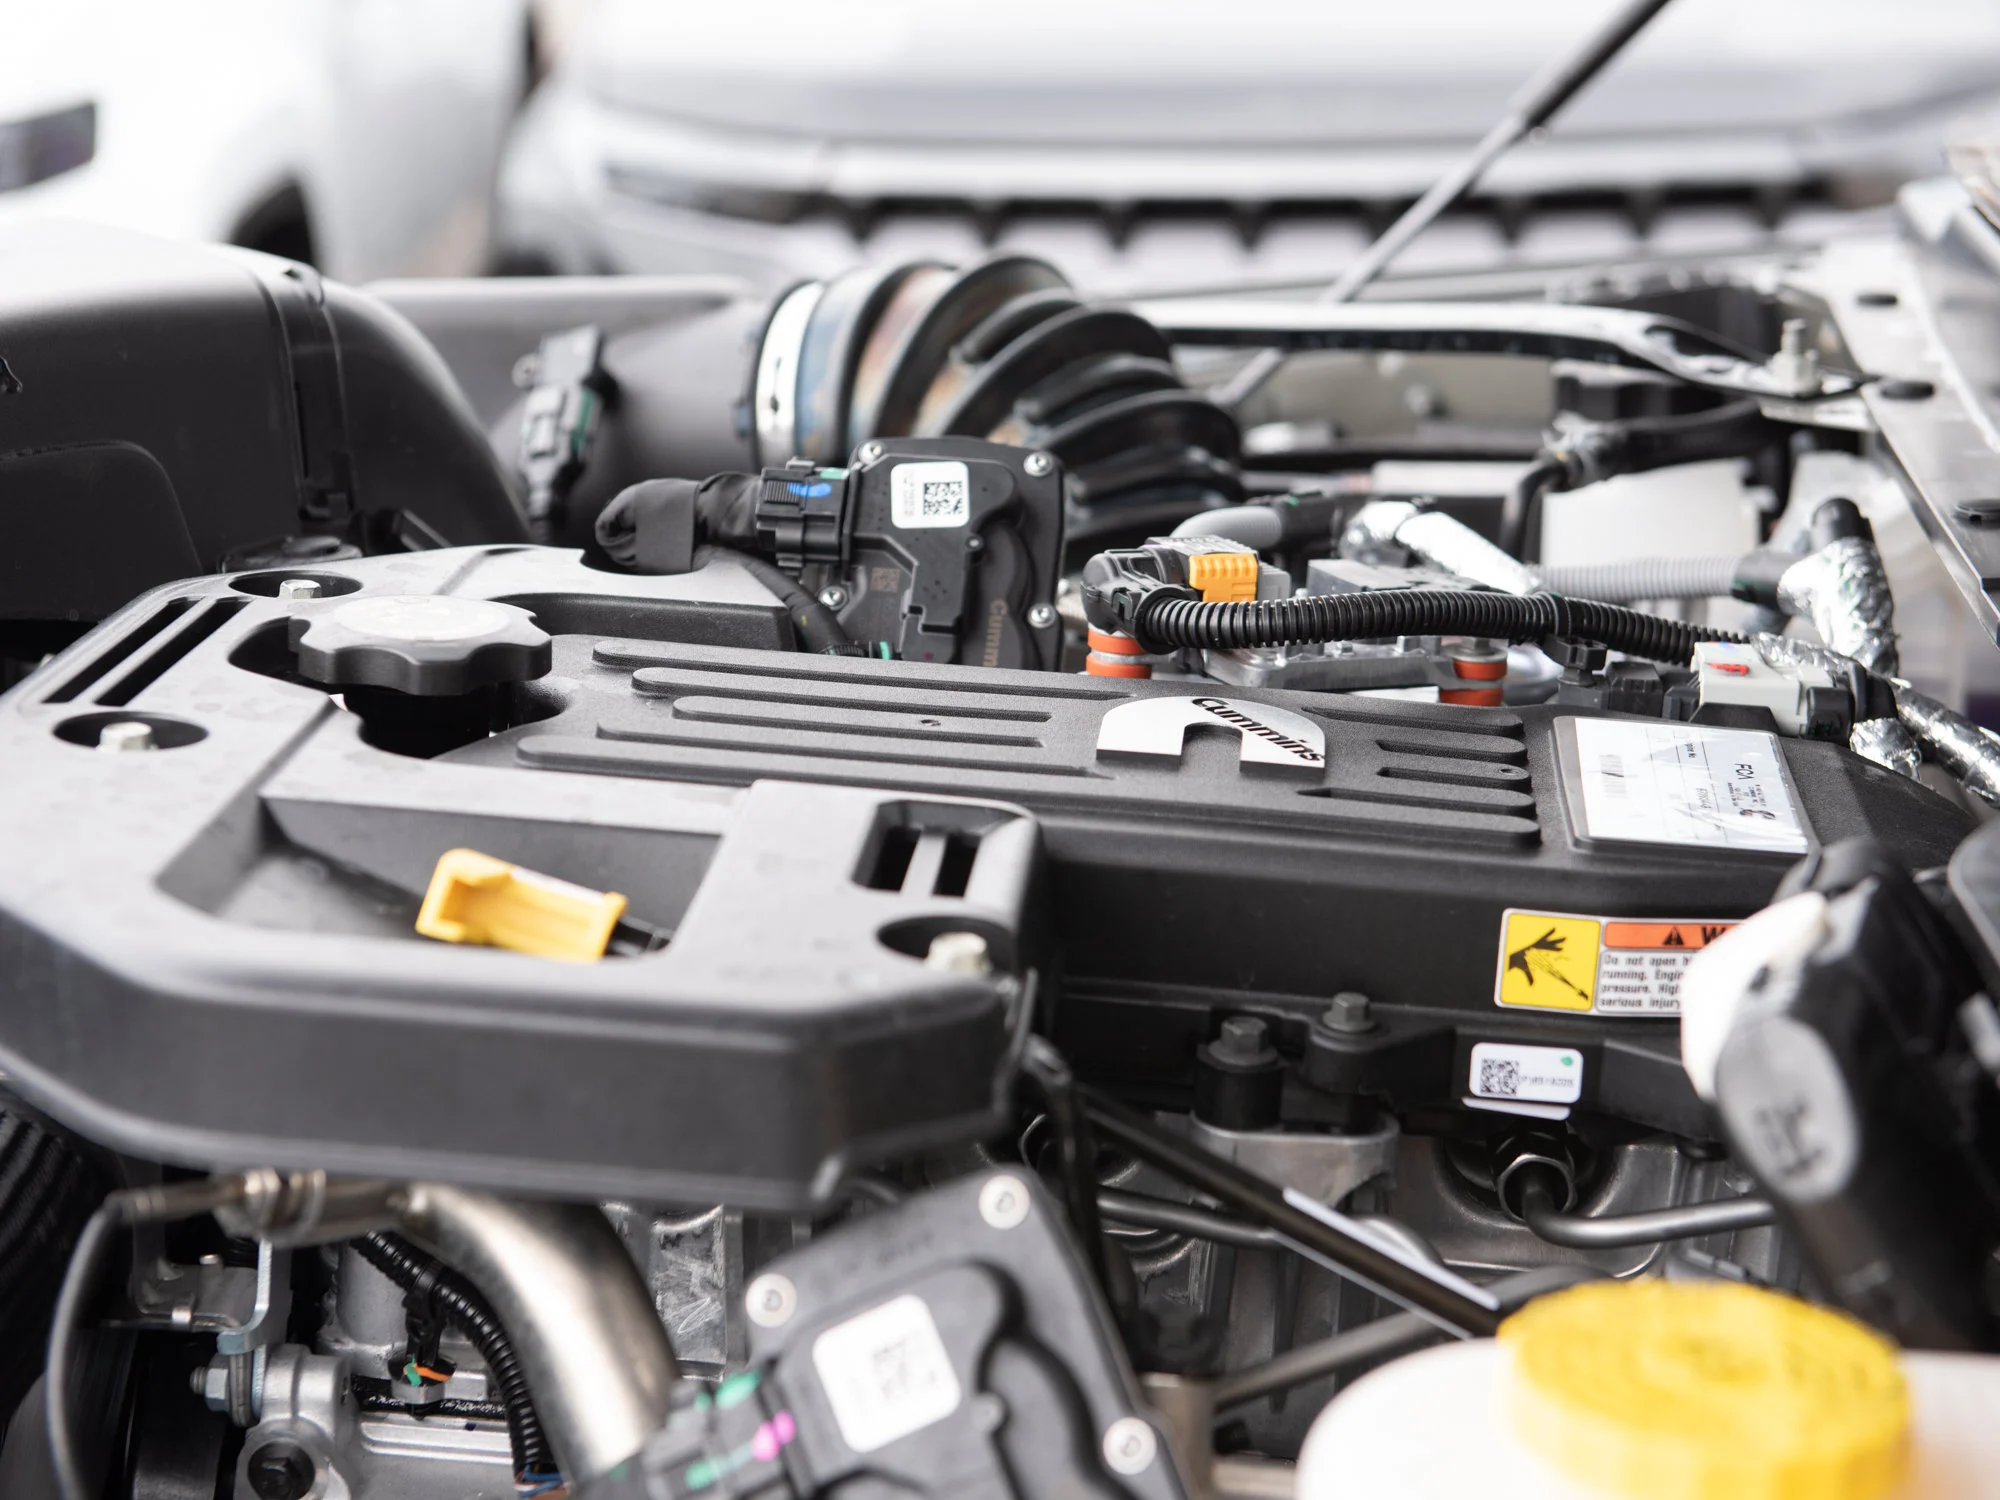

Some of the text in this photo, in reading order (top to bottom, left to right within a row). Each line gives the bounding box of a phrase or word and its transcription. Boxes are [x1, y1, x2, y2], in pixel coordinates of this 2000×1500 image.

[983, 599, 1008, 667] Cumm
[1192, 698, 1325, 762] Cummins
[1735, 763, 1755, 779] FCA
[1604, 955, 1618, 965] Do
[1625, 956, 1644, 966] not
[1650, 956, 1676, 967] open
[1602, 970, 1647, 981] running.
[1601, 985, 1651, 995] pressure.
[1600, 997, 1680, 1010] serious injury
